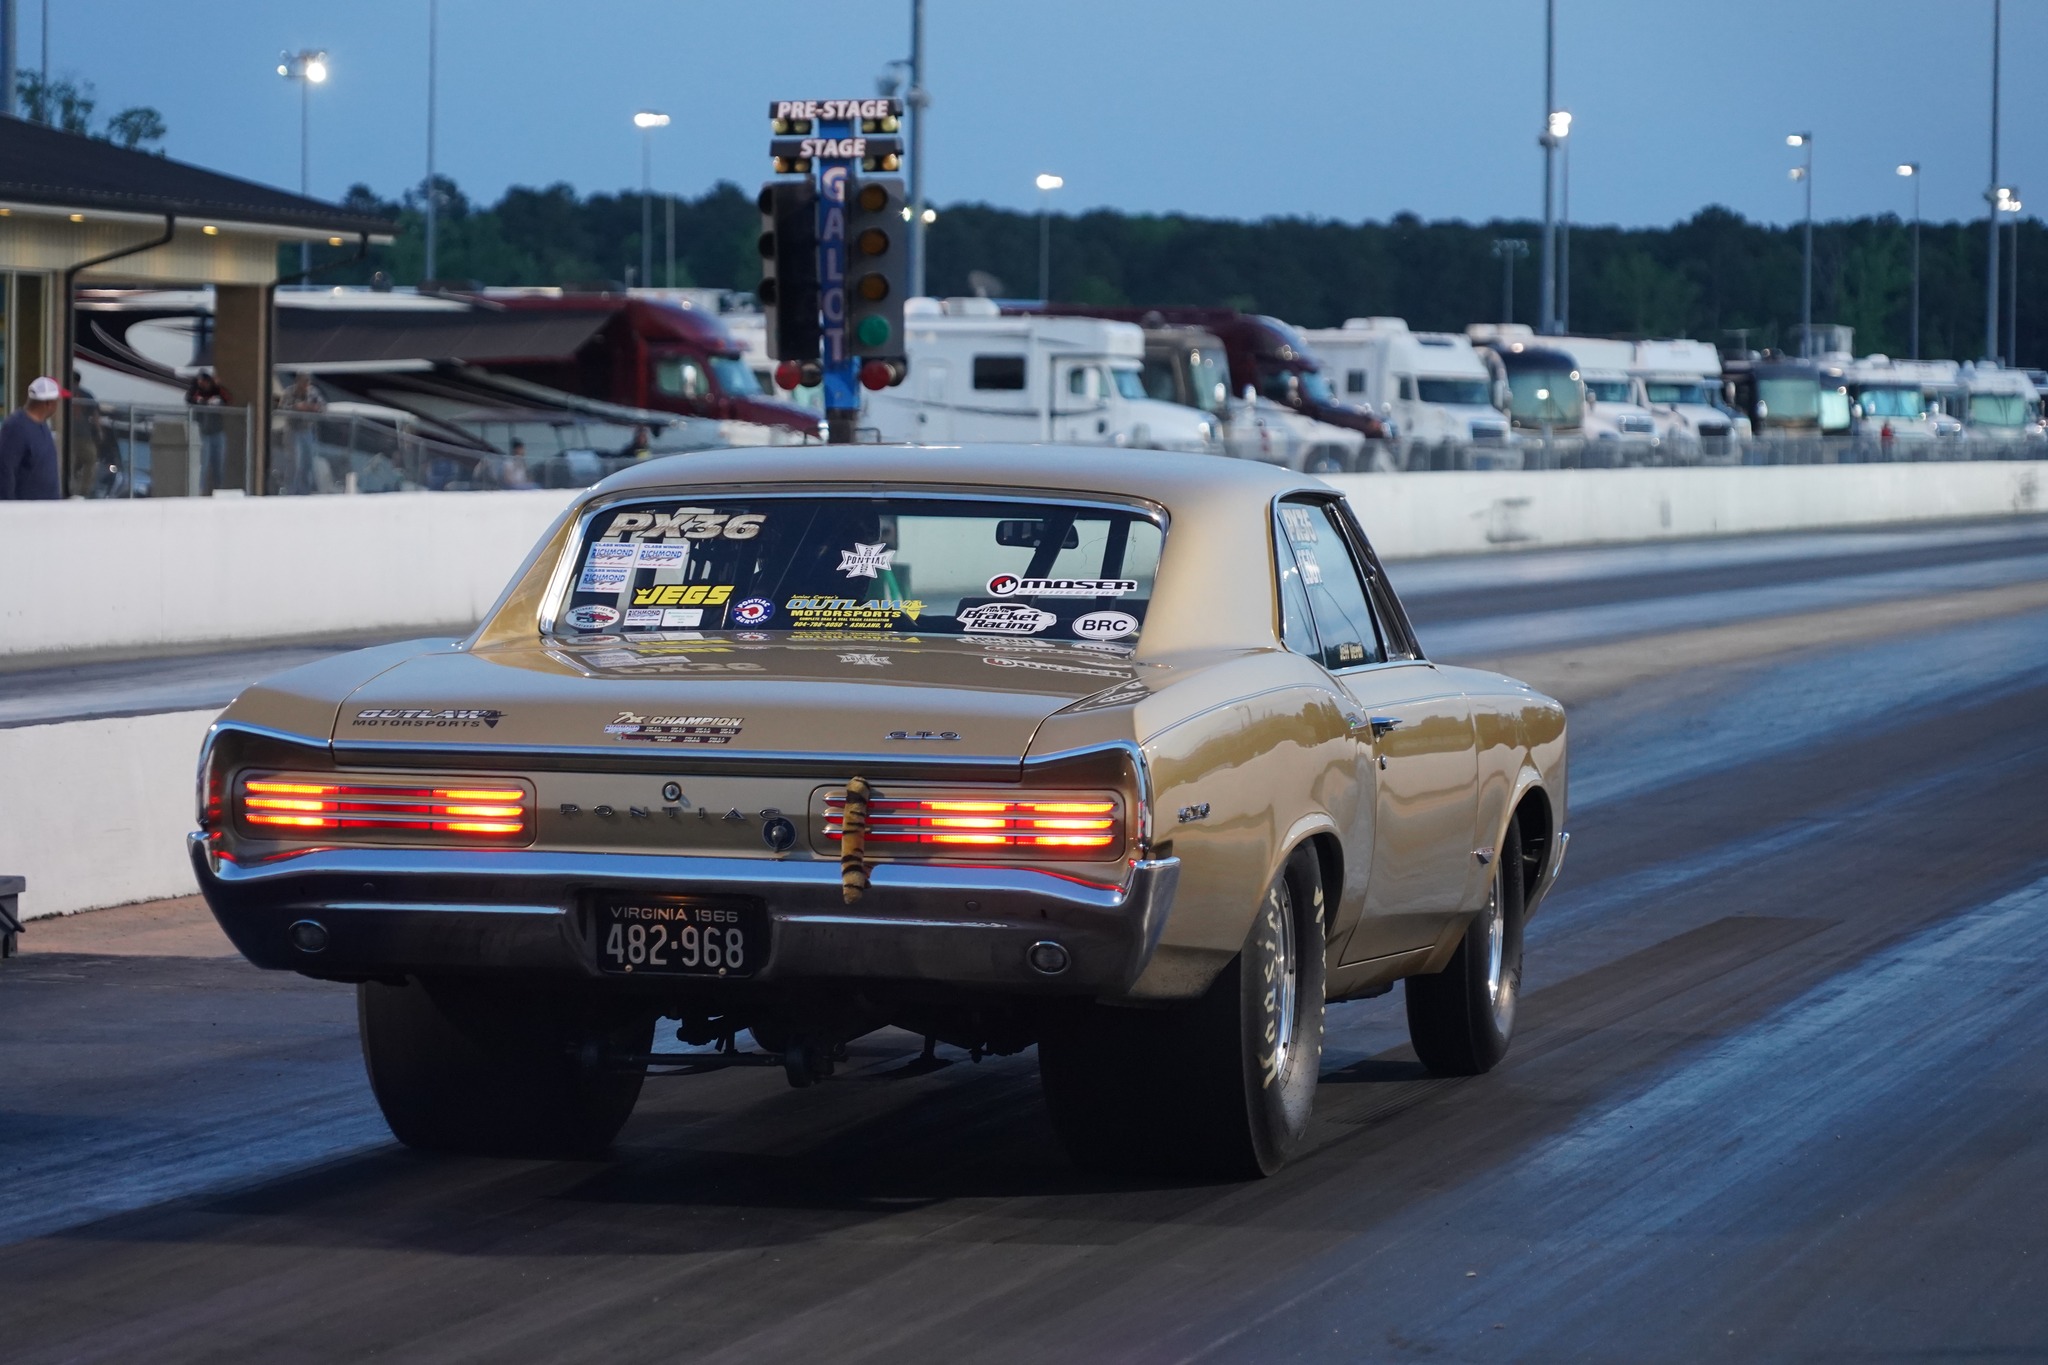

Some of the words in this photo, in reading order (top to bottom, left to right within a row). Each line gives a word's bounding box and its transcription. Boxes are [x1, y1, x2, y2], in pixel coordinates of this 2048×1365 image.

[777, 100, 889, 119] PRE-STAGE
[800, 139, 866, 158] STAGE
[820, 166, 847, 362] GALOT
[603, 512, 768, 540] PX36
[591, 548, 634, 559] RICHMOND
[640, 549, 683, 560] RICHMOND
[846, 555, 886, 565] PONTIAC
[583, 573, 626, 583] RICHMOND
[1020, 580, 1136, 590] MOSER
[633, 584, 735, 606] JEGS
[737, 598, 771, 609] PONTIAC
[785, 598, 911, 611] OUTLAW
[628, 609, 660, 618] RICHMOND
[735, 614, 768, 625] SERVICE
[790, 610, 902, 618] MOTORSPORTS
[964, 609, 1041, 622] Bracket
[970, 619, 1037, 631] Racing
[1082, 619, 1128, 631] BRC
[356, 708, 487, 719] OUTLAW
[352, 719, 480, 728] MOTORSPORTS
[650, 715, 745, 727] CHAMPION
[559, 803, 782, 821] PONTIAC
[610, 906, 688, 921] VIRGINIA
[695, 909, 739, 923] 1966
